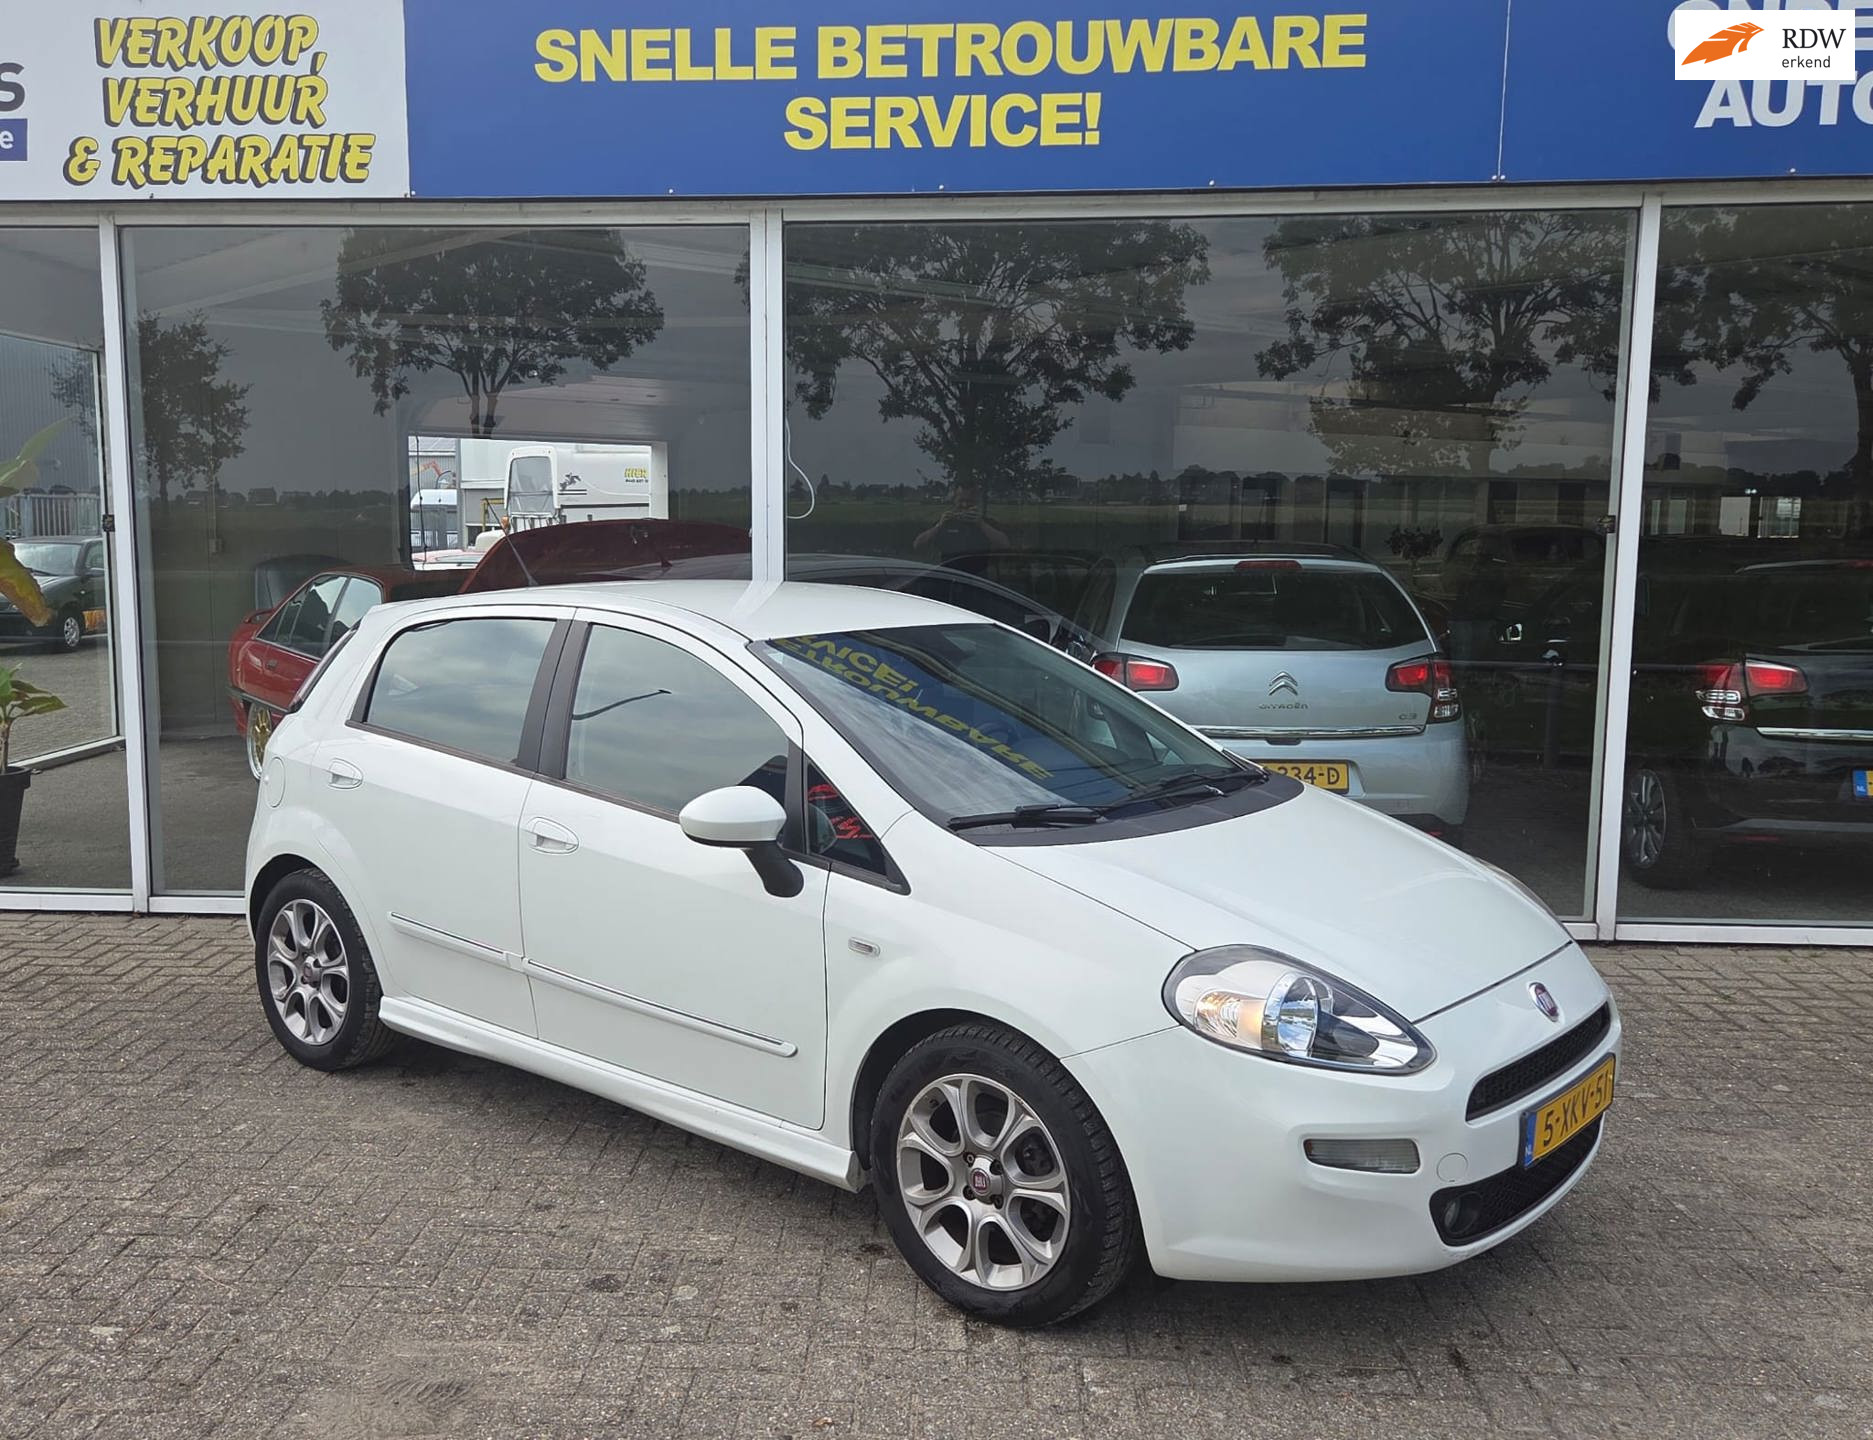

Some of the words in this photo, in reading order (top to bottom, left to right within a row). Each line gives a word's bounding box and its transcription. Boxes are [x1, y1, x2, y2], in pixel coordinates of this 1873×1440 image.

[94, 15, 327, 73] VERKOOP,
[534, 28, 797, 82] SNELLE
[818, 14, 1367, 77] BETROUWBARE
[103, 75, 328, 131] VERHUUR
[784, 93, 1101, 150] SERVICE!
[63, 137, 100, 186] &
[112, 133, 376, 189] REPARATIE
[1543, 1070, 1609, 1147] 5-XKV-51
